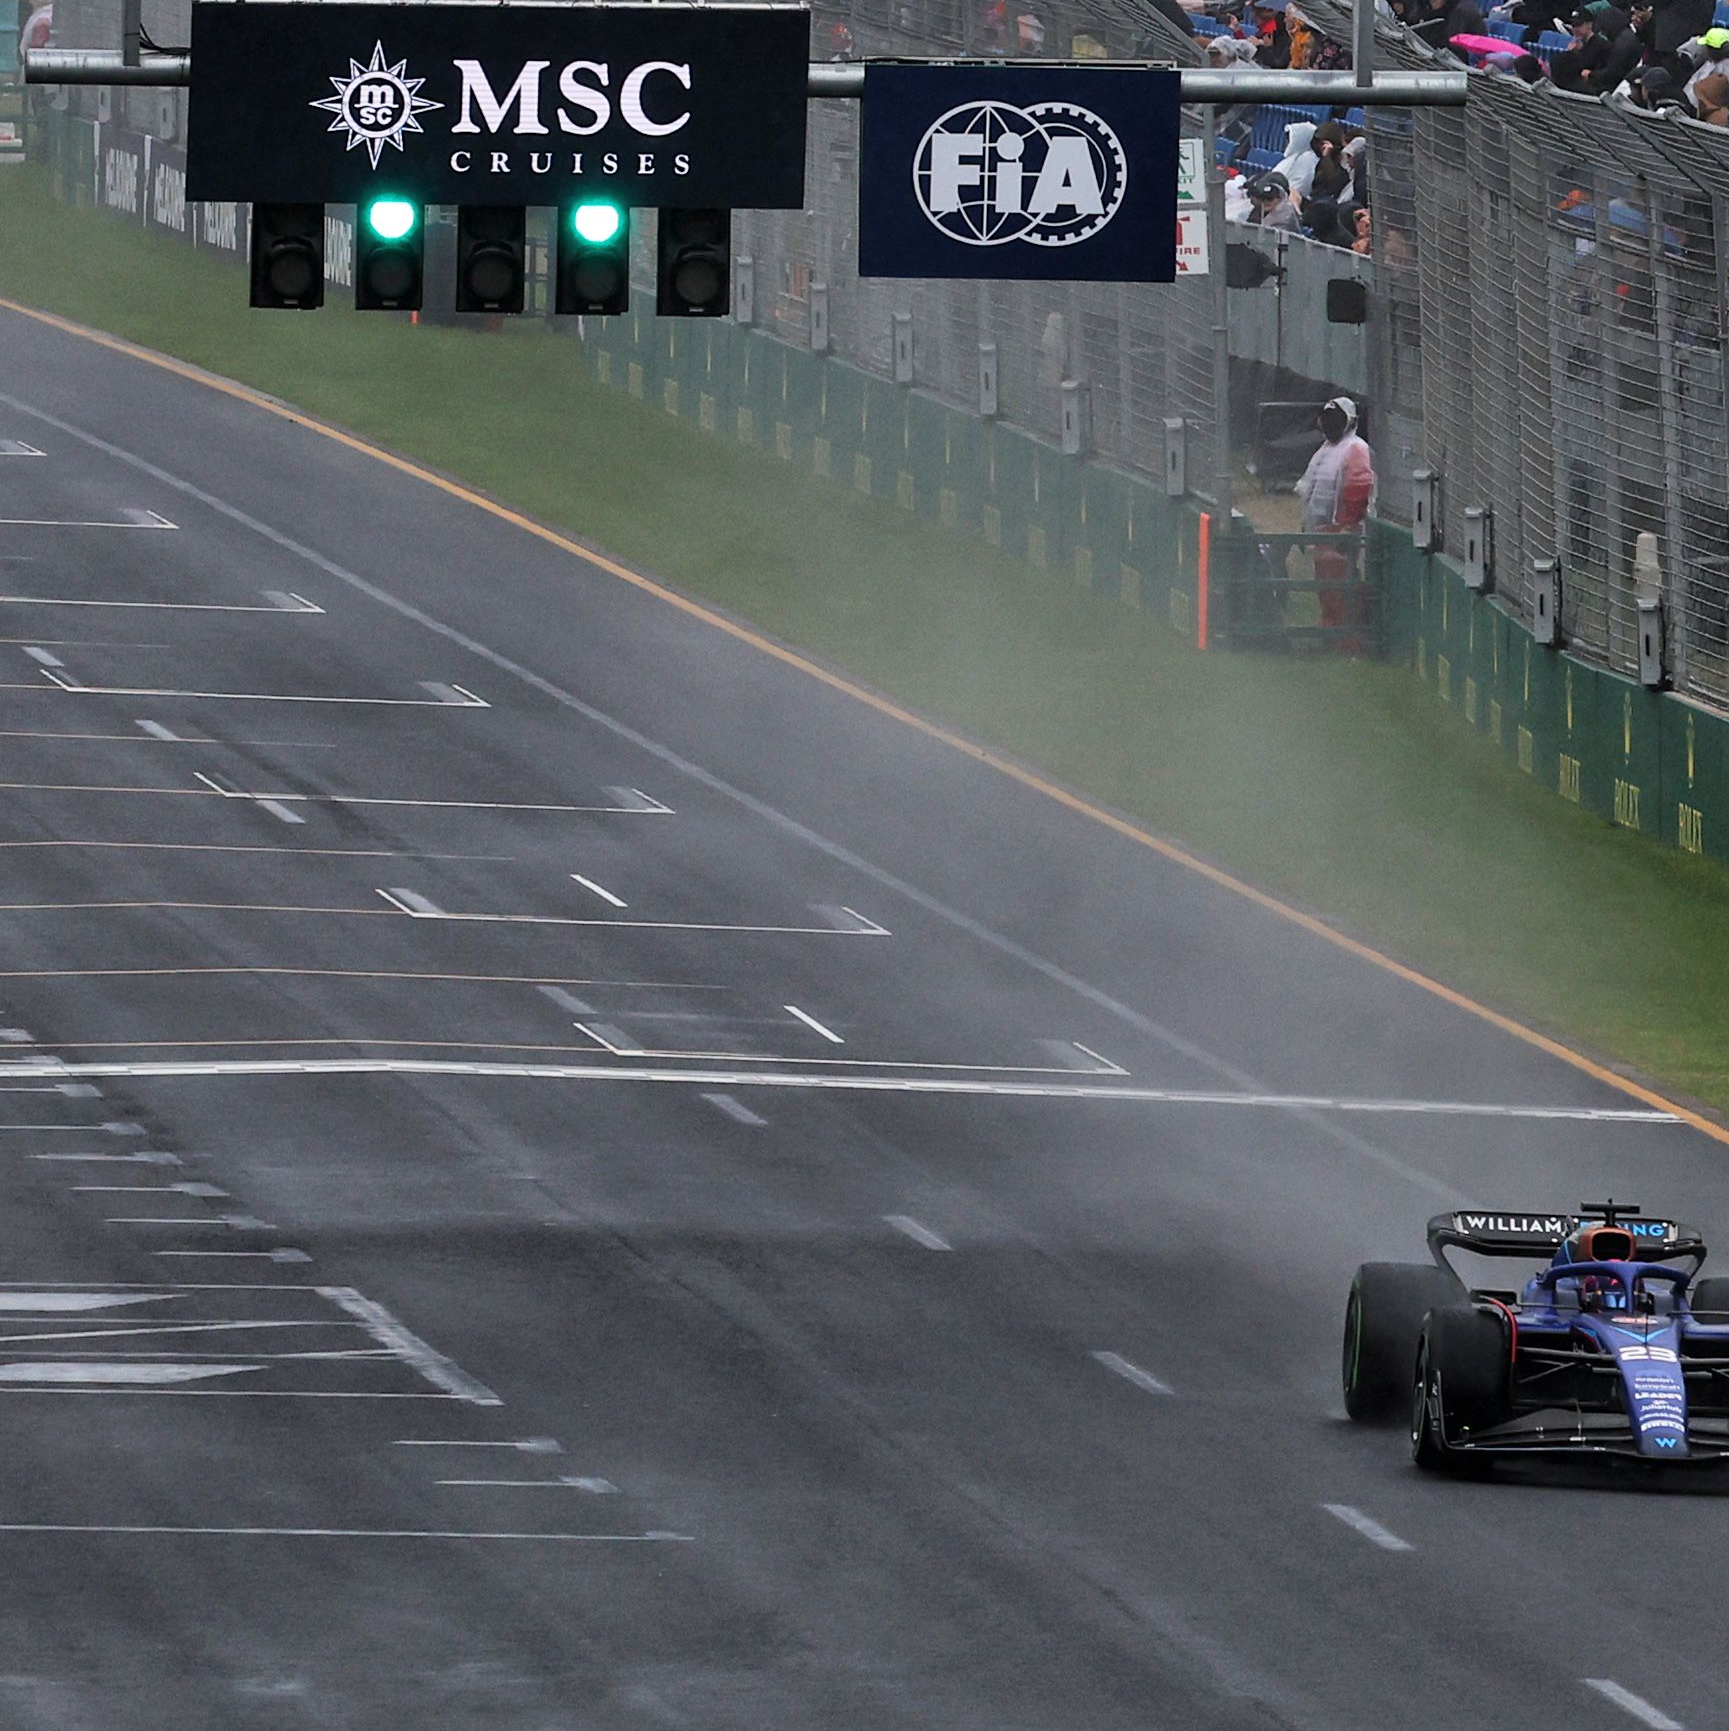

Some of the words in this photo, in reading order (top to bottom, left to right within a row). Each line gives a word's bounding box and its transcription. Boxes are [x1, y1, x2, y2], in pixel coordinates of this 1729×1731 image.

[452, 60, 692, 136] MSC
[451, 152, 691, 175] CRUISES
[1176, 247, 1201, 255] IRE
[1466, 1215, 1567, 1236] WILLIAM
[1618, 1345, 1678, 1363] 23
